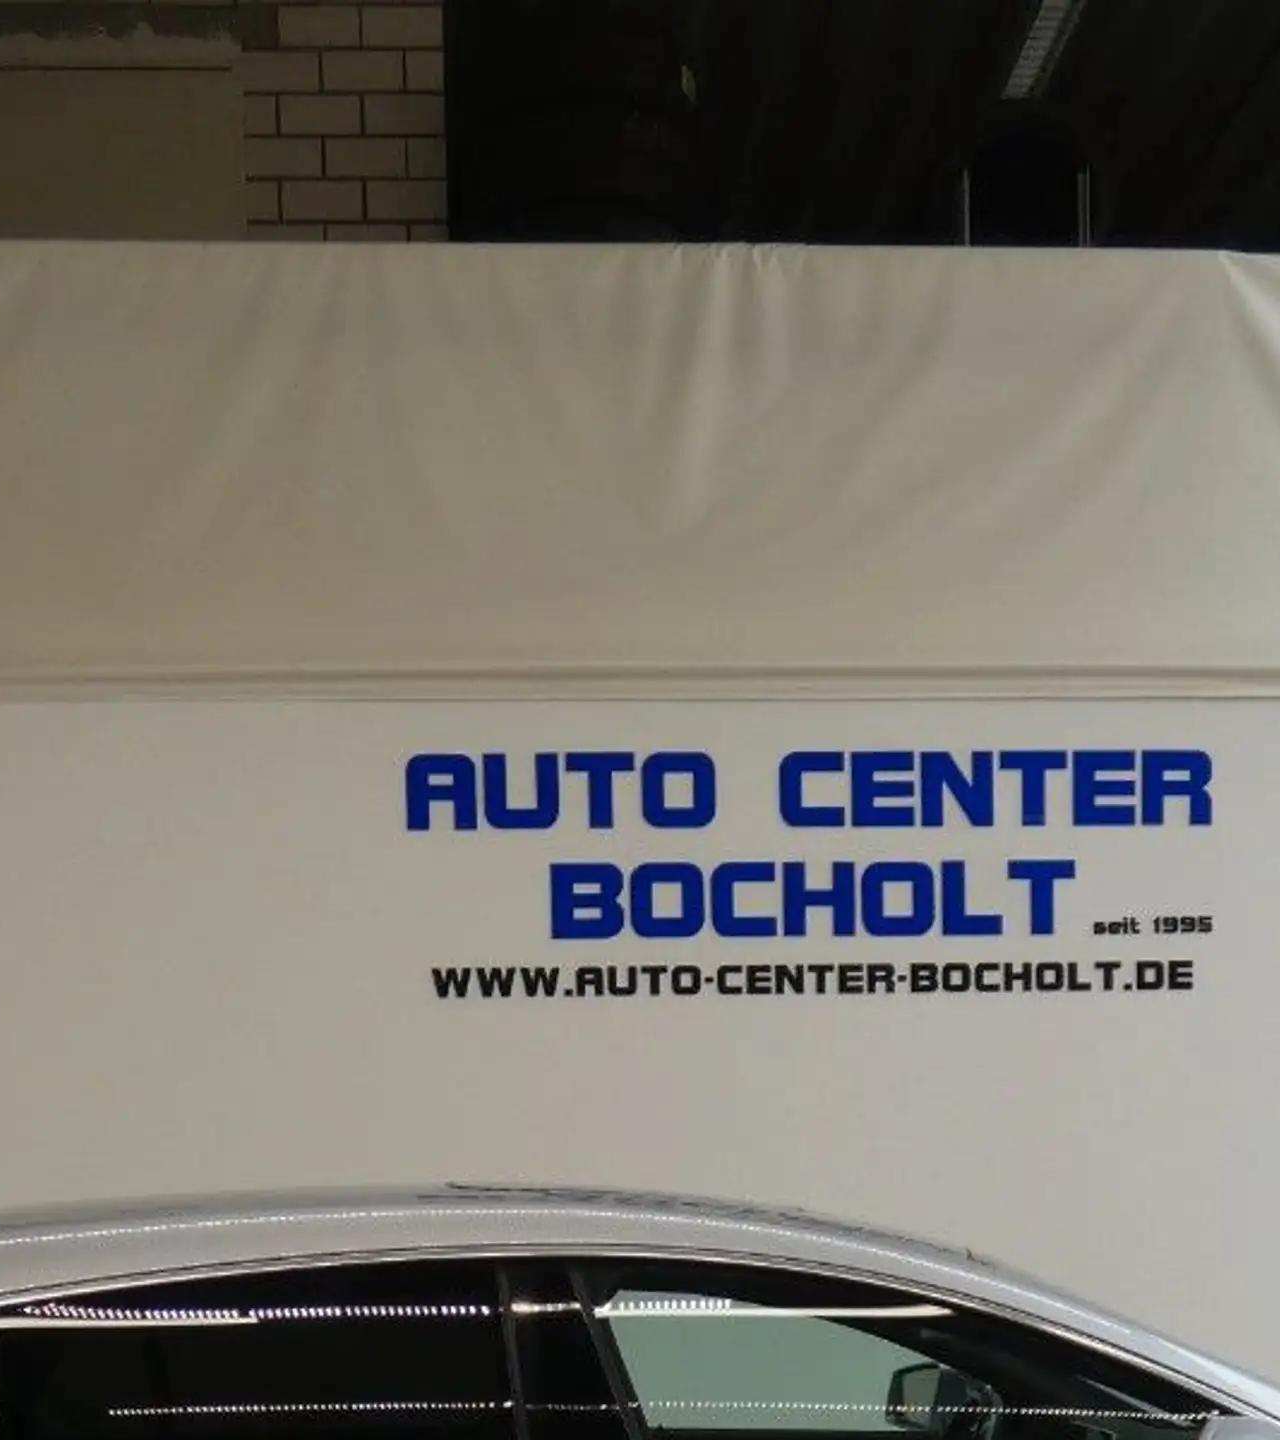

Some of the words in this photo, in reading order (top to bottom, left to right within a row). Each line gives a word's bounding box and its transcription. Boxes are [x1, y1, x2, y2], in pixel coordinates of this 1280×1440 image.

[405, 752, 717, 831] AUTO
[778, 749, 1214, 828] CENTER
[549, 859, 1076, 940] BOCHOLT
[1092, 915, 1141, 936] seit
[1152, 914, 1214, 935] 1995
[430, 958, 1195, 1000] WWW.AUTO-CENTER-BOCHOLT.DE
